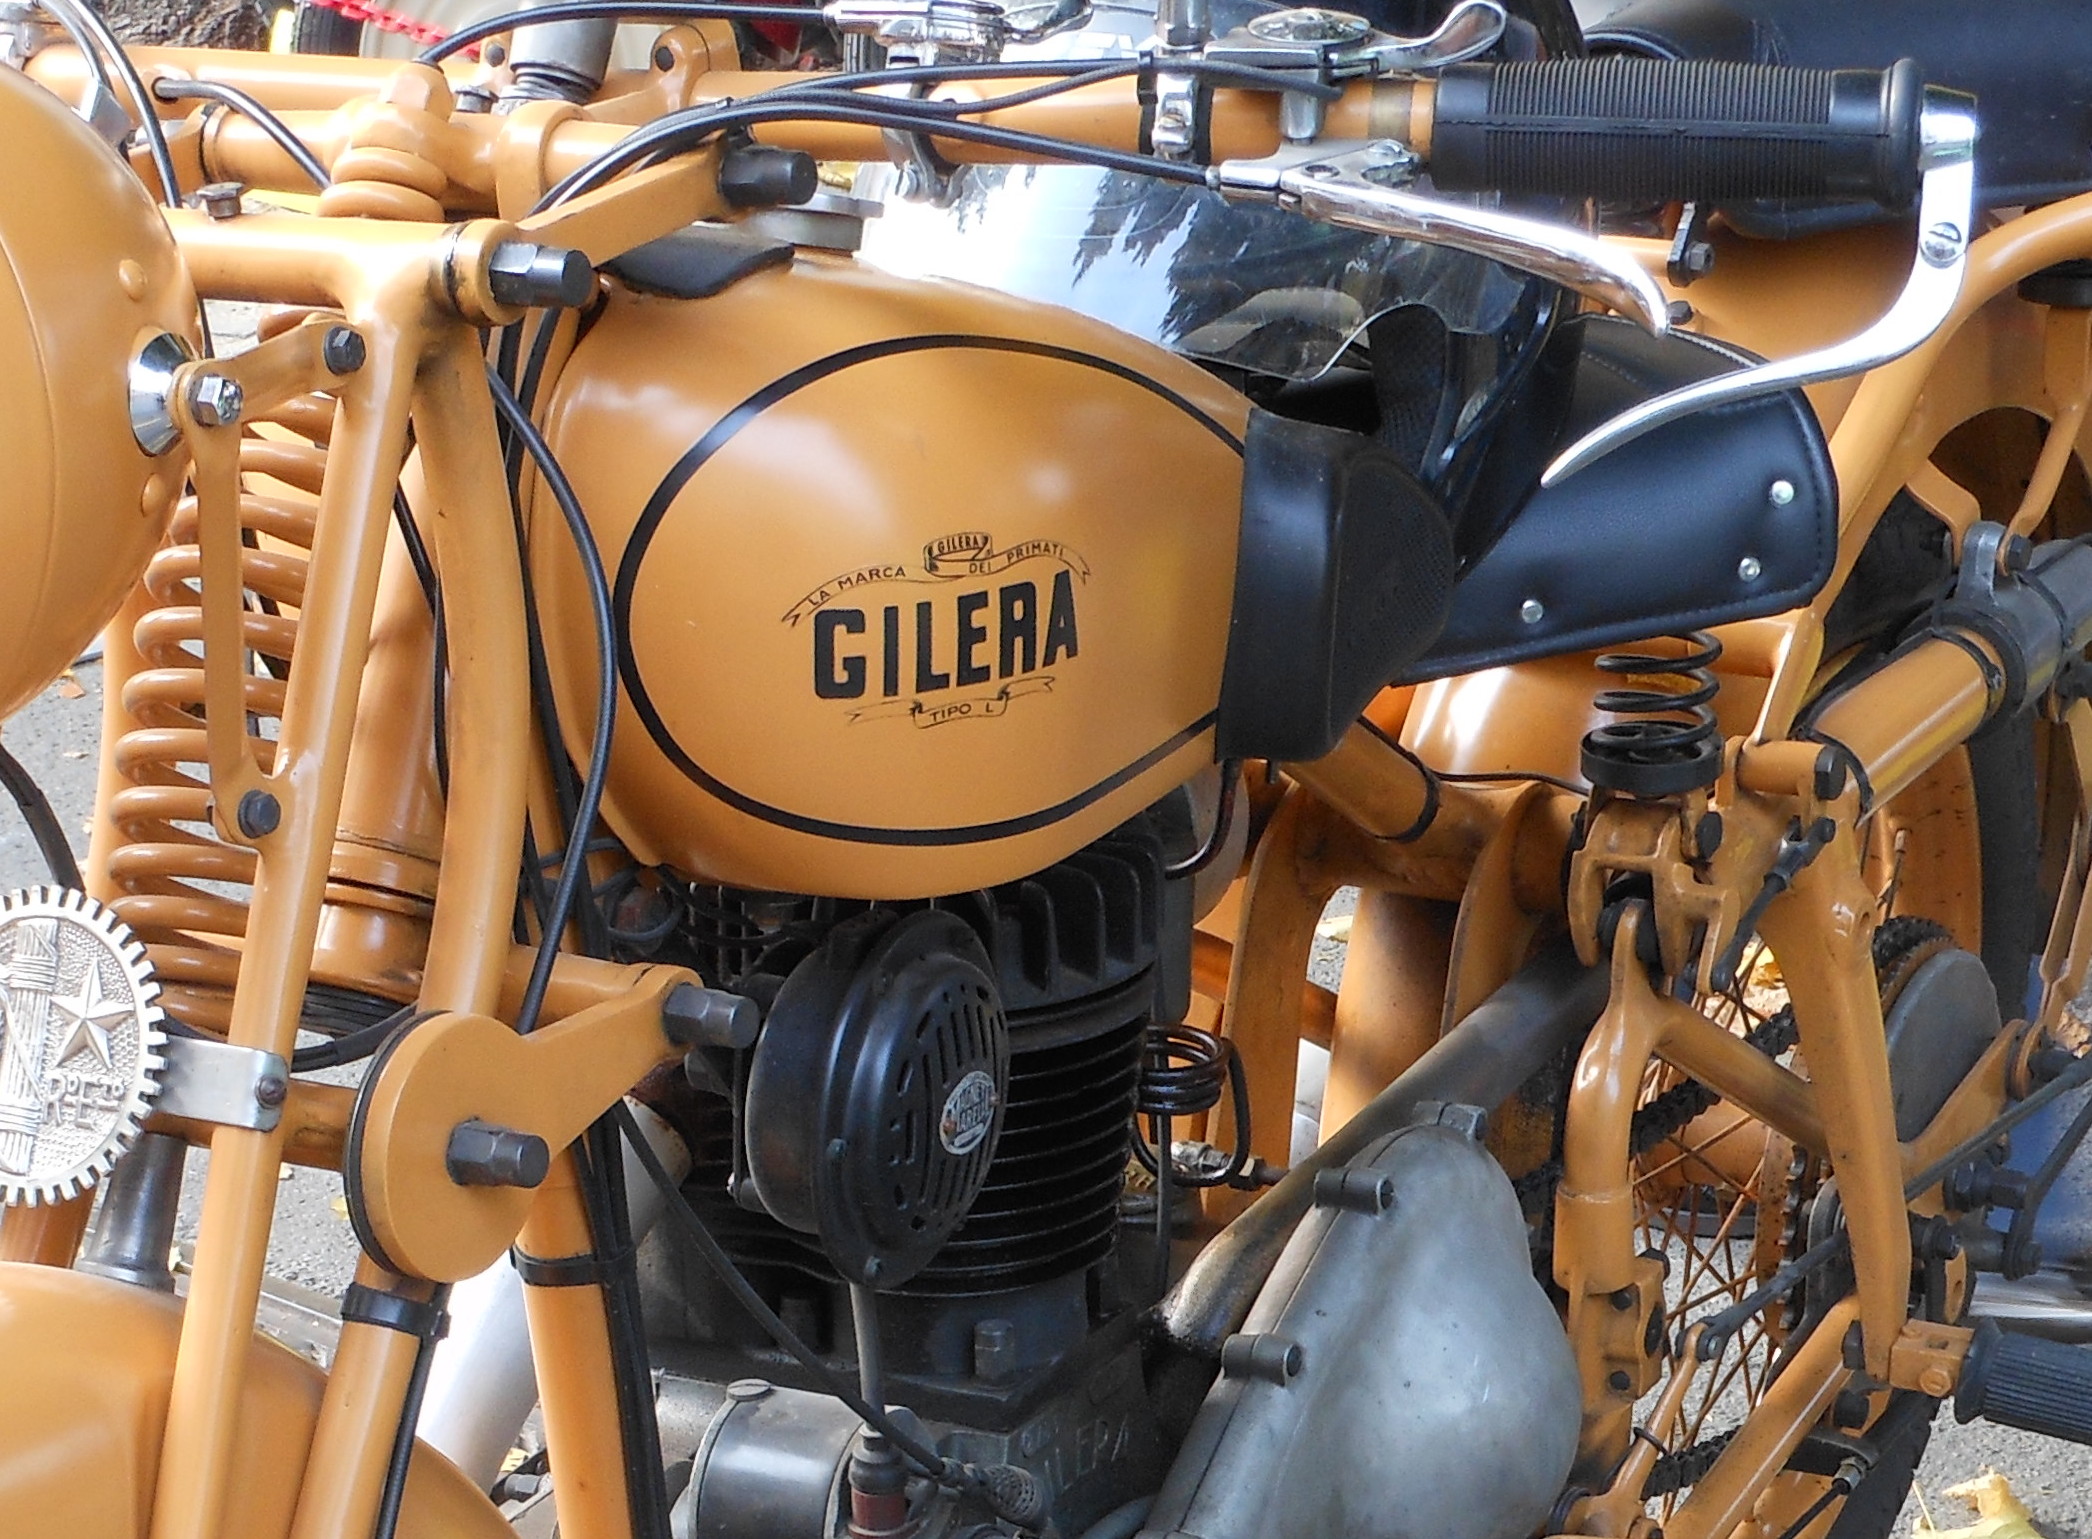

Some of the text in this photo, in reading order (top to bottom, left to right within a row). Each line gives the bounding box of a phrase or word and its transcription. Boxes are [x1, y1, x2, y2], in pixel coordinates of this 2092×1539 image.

[937, 535, 979, 554] GILERA
[807, 541, 1064, 606] LA MARCA DEI PRIMATI
[815, 569, 1078, 699] GILERA
[929, 702, 994, 722] TIPO L
